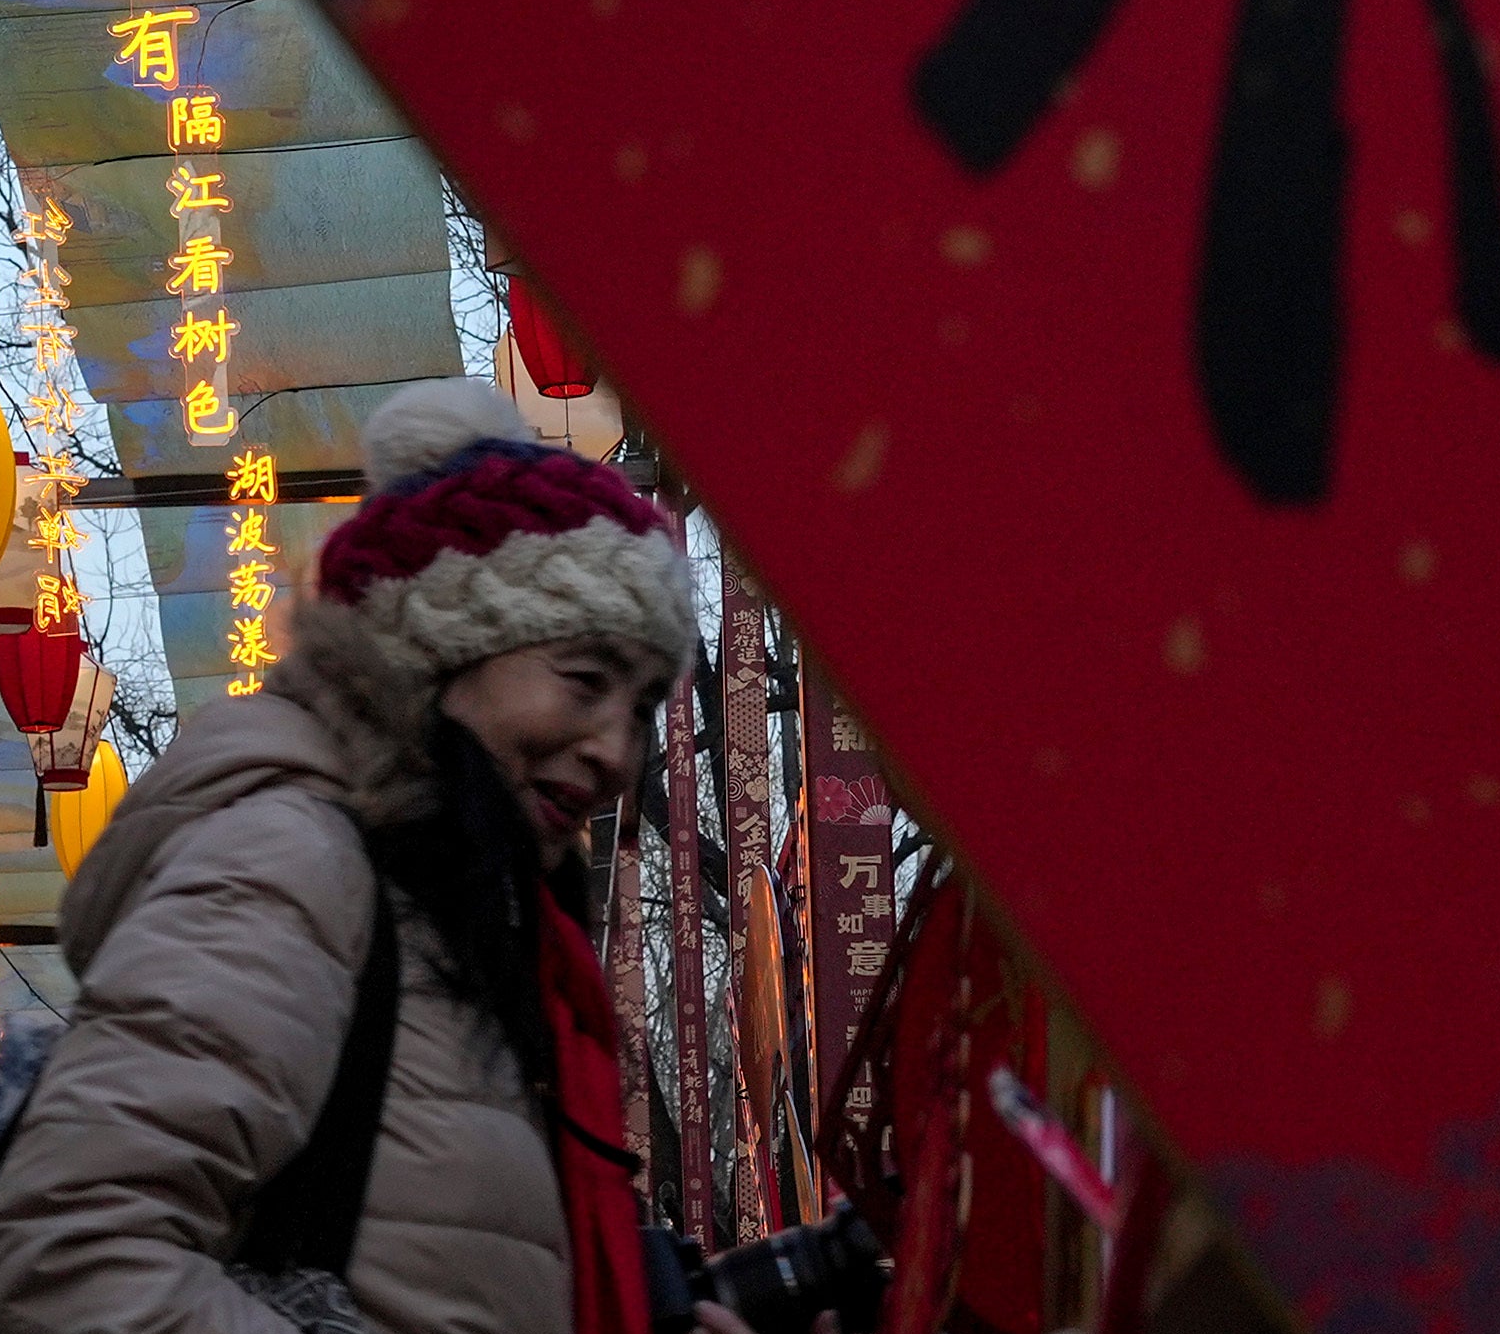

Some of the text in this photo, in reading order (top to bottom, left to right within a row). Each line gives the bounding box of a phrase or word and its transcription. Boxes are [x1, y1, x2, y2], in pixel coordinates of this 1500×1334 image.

[168, 97, 235, 436] 隔江看树色
[837, 855, 892, 977] 万事如意
